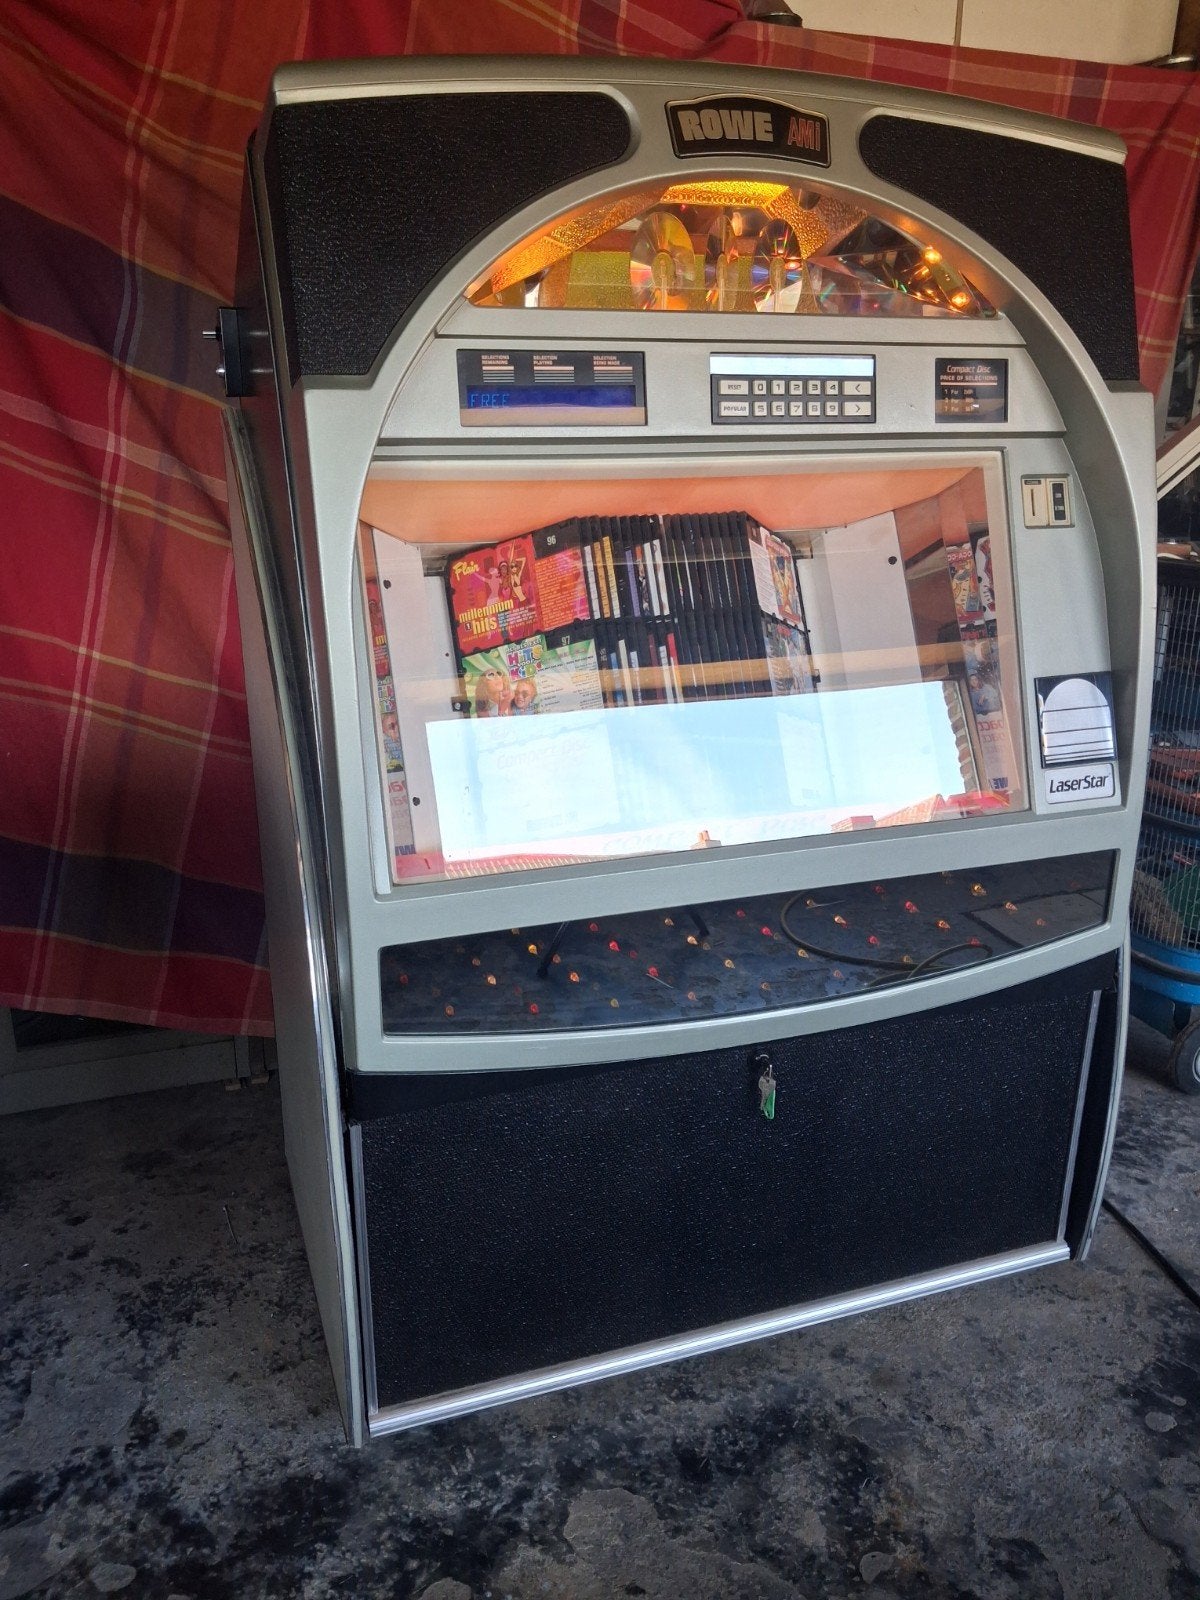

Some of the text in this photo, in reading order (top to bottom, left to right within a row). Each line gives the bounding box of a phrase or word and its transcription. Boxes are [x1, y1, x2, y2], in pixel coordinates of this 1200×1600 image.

[677, 109, 774, 142] ROWE
[946, 365, 992, 374] Compact Disc
[757, 383, 764, 391] 0
[775, 383, 781, 391] 1
[811, 383, 819, 391] 3
[470, 393, 510, 408] FREE
[757, 405, 764, 413] 5
[793, 405, 800, 413] 7
[546, 534, 557, 546] 96
[459, 599, 515, 624] millennium
[472, 616, 498, 635] hits
[561, 635, 571, 646] 97
[1049, 774, 1109, 794] LaserStar
